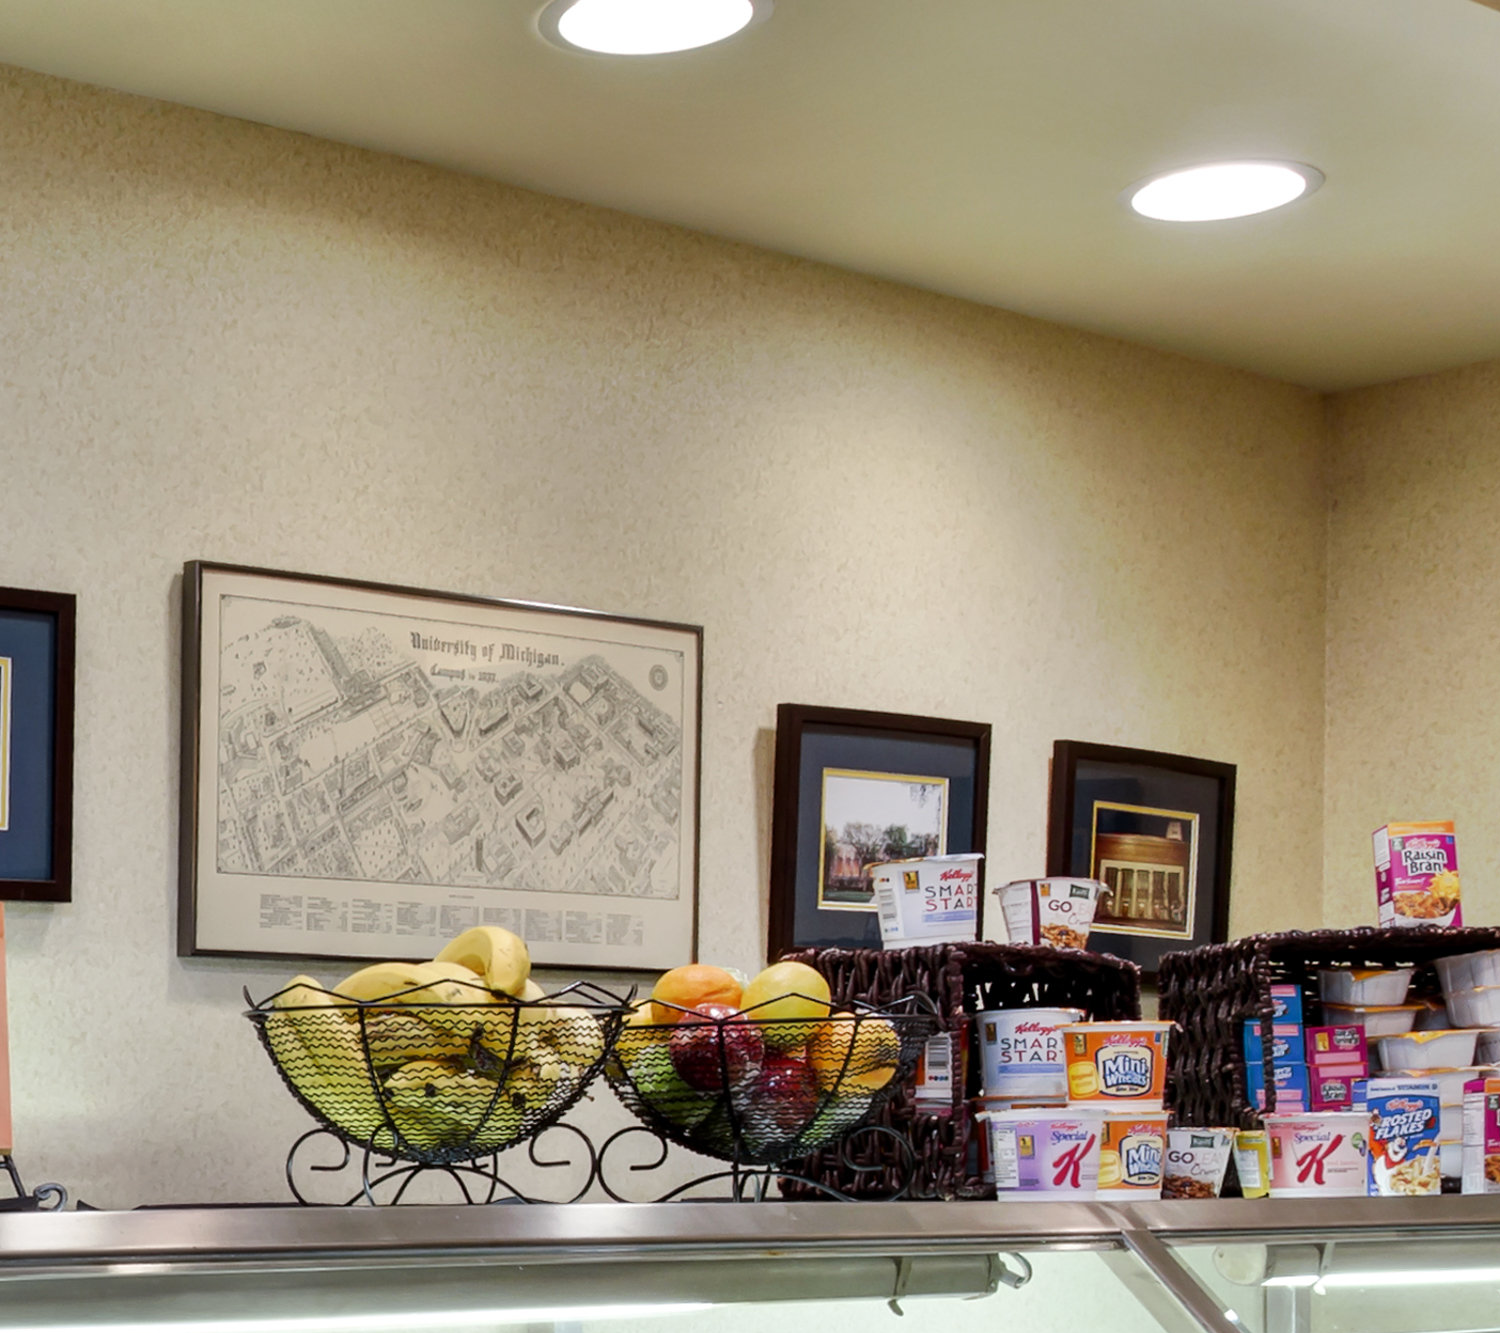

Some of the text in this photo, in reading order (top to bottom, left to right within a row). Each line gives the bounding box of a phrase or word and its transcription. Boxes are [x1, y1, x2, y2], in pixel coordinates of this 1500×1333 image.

[409, 631, 478, 662] University
[481, 643, 495, 663] of
[1403, 850, 1446, 863] Raisin
[1409, 861, 1442, 874] Bran
[924, 884, 978, 899] SMAR
[925, 897, 978, 912] STAR
[1000, 1037, 1064, 1050] SMAR
[1000, 1049, 1064, 1064] STAR
[1051, 1130, 1088, 1145] Special
[1294, 1131, 1331, 1144] Special
[1374, 1120, 1426, 1140] FLAKES
[1052, 1133, 1097, 1189] K
[1296, 1133, 1344, 1185] K
